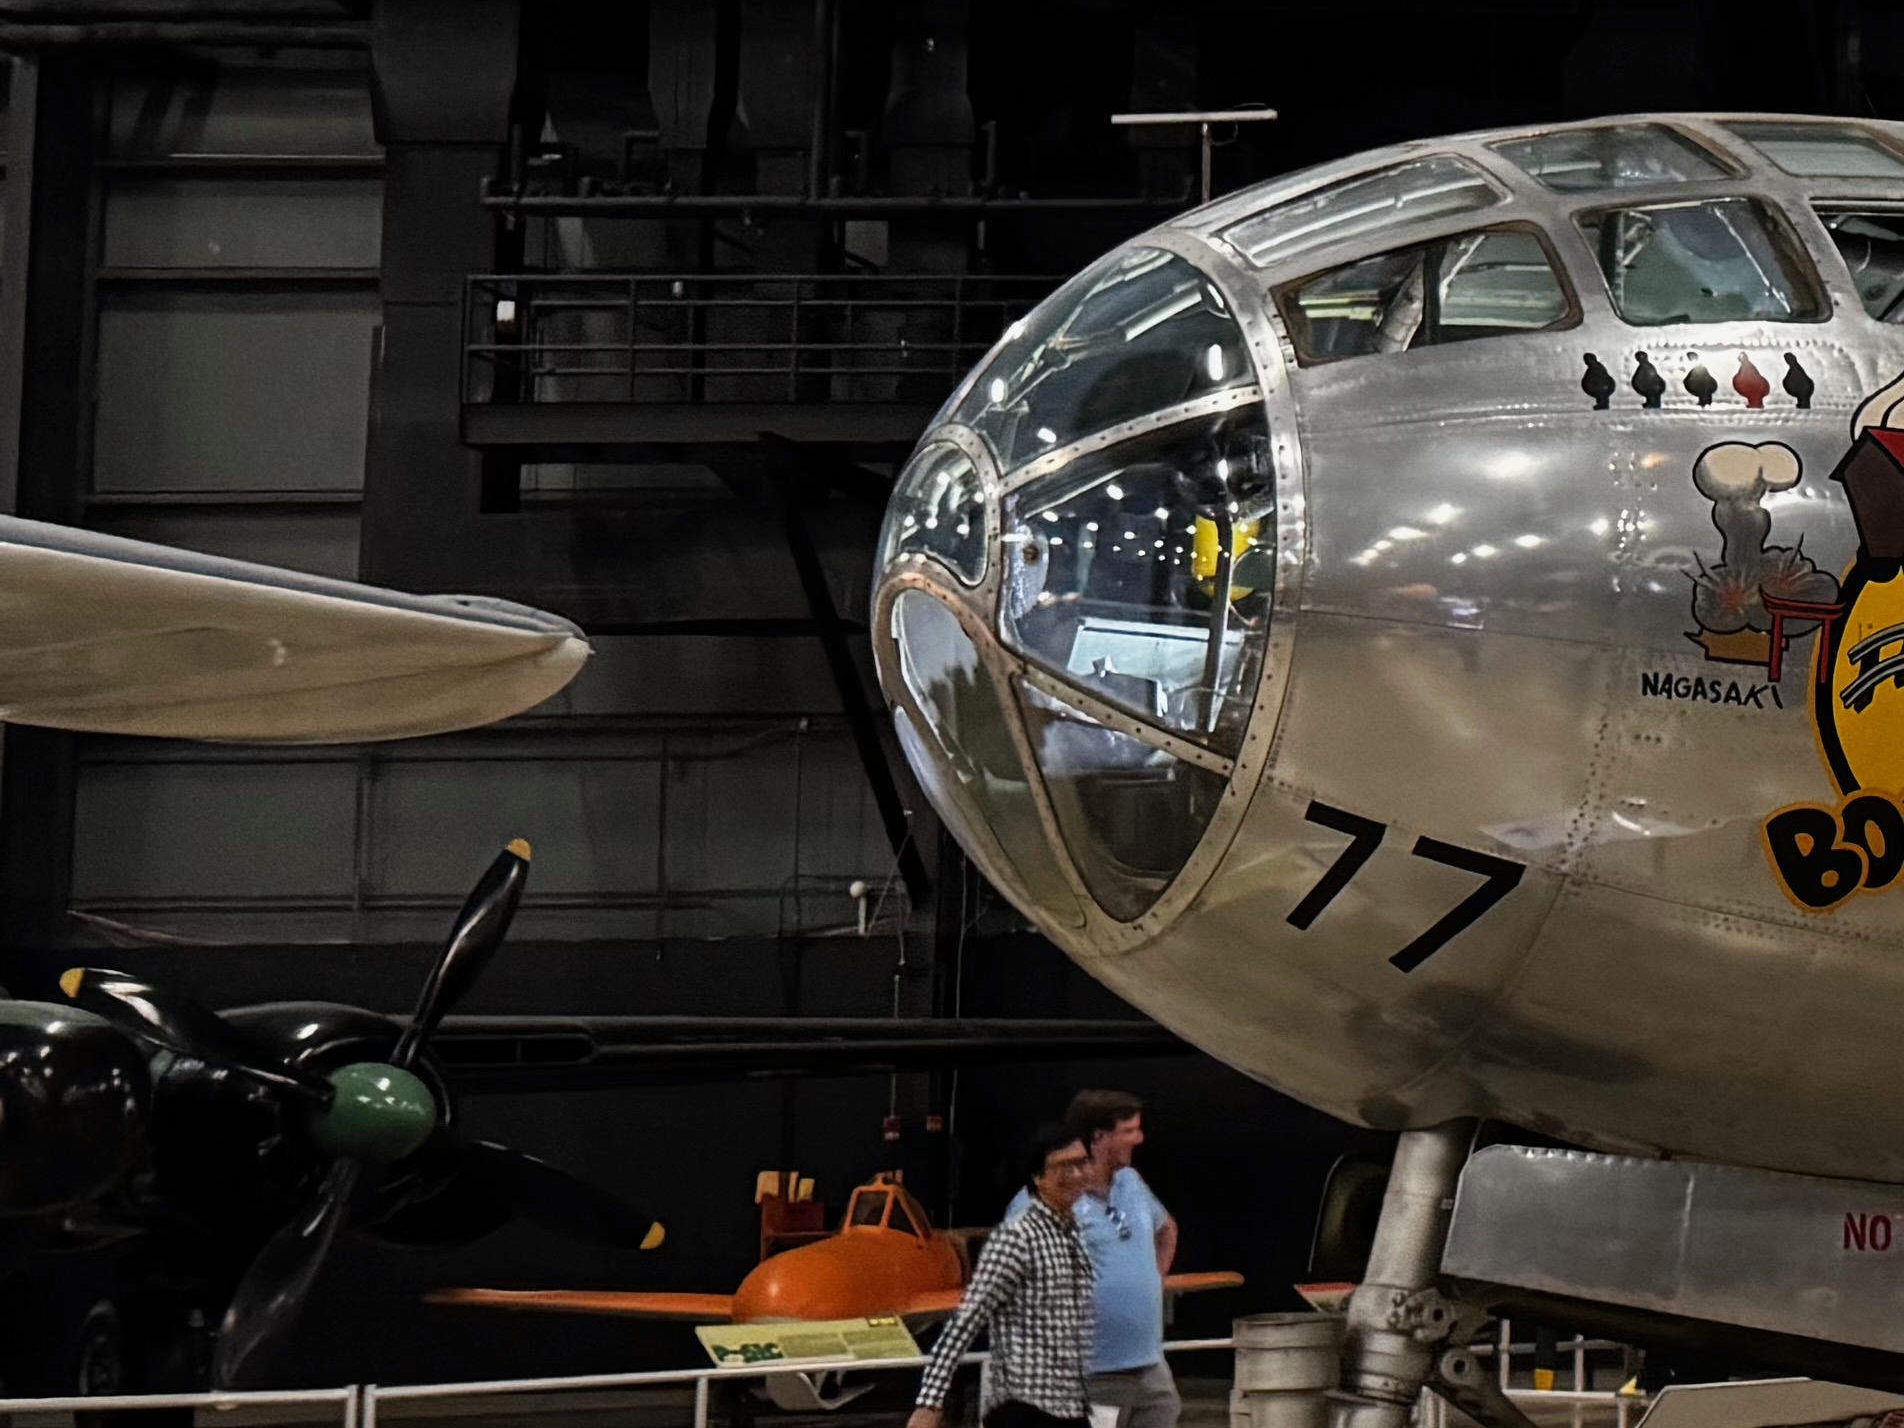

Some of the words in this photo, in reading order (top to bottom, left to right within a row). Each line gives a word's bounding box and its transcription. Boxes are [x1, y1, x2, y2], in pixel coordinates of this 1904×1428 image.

[1641, 672, 1783, 709] NAGASAKI
[1286, 799, 1527, 973] 77
[1843, 1212, 1892, 1252] NO
